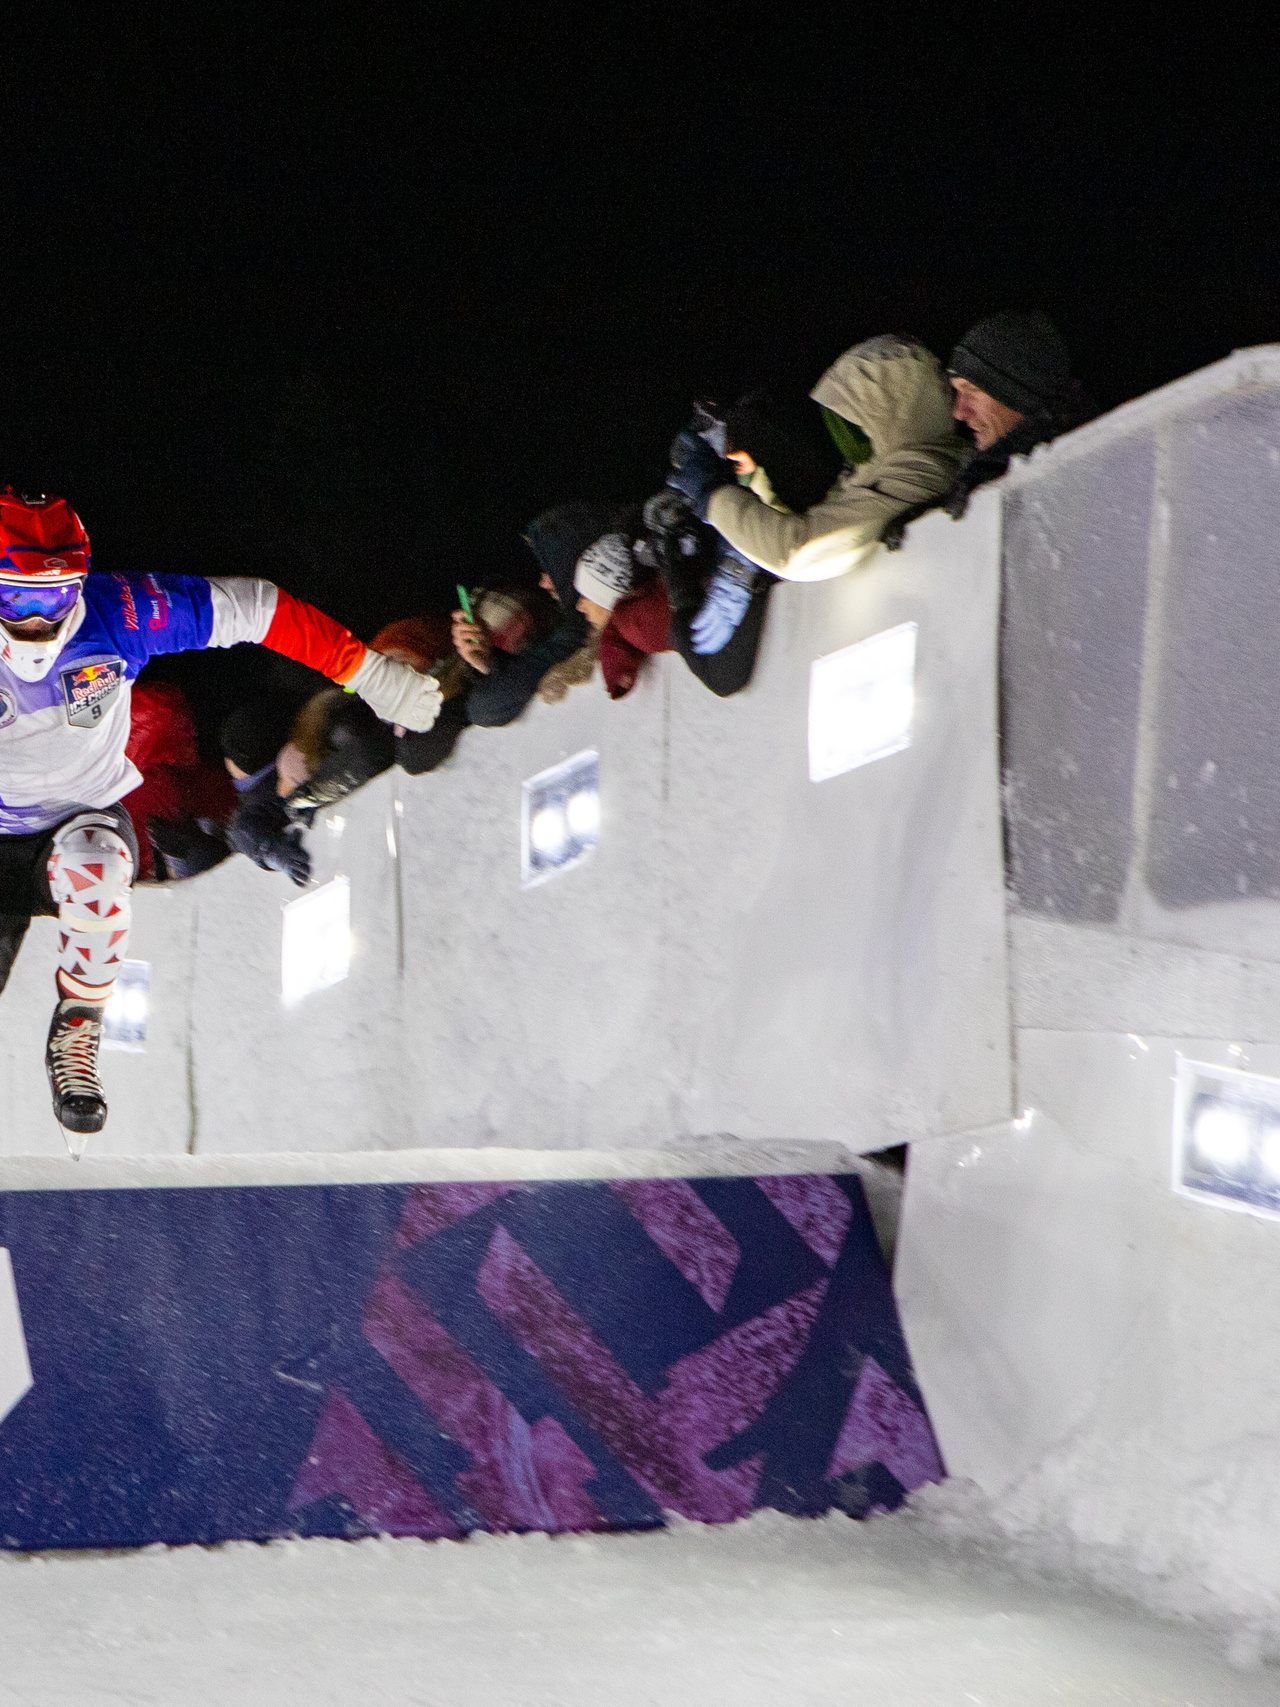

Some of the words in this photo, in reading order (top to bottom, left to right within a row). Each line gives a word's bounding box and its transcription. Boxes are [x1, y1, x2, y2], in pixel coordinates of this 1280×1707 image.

[71, 680, 97, 701] Red
[95, 670, 117, 690] Bull
[69, 697, 89, 717] ICE
[91, 704, 102, 720] 9
